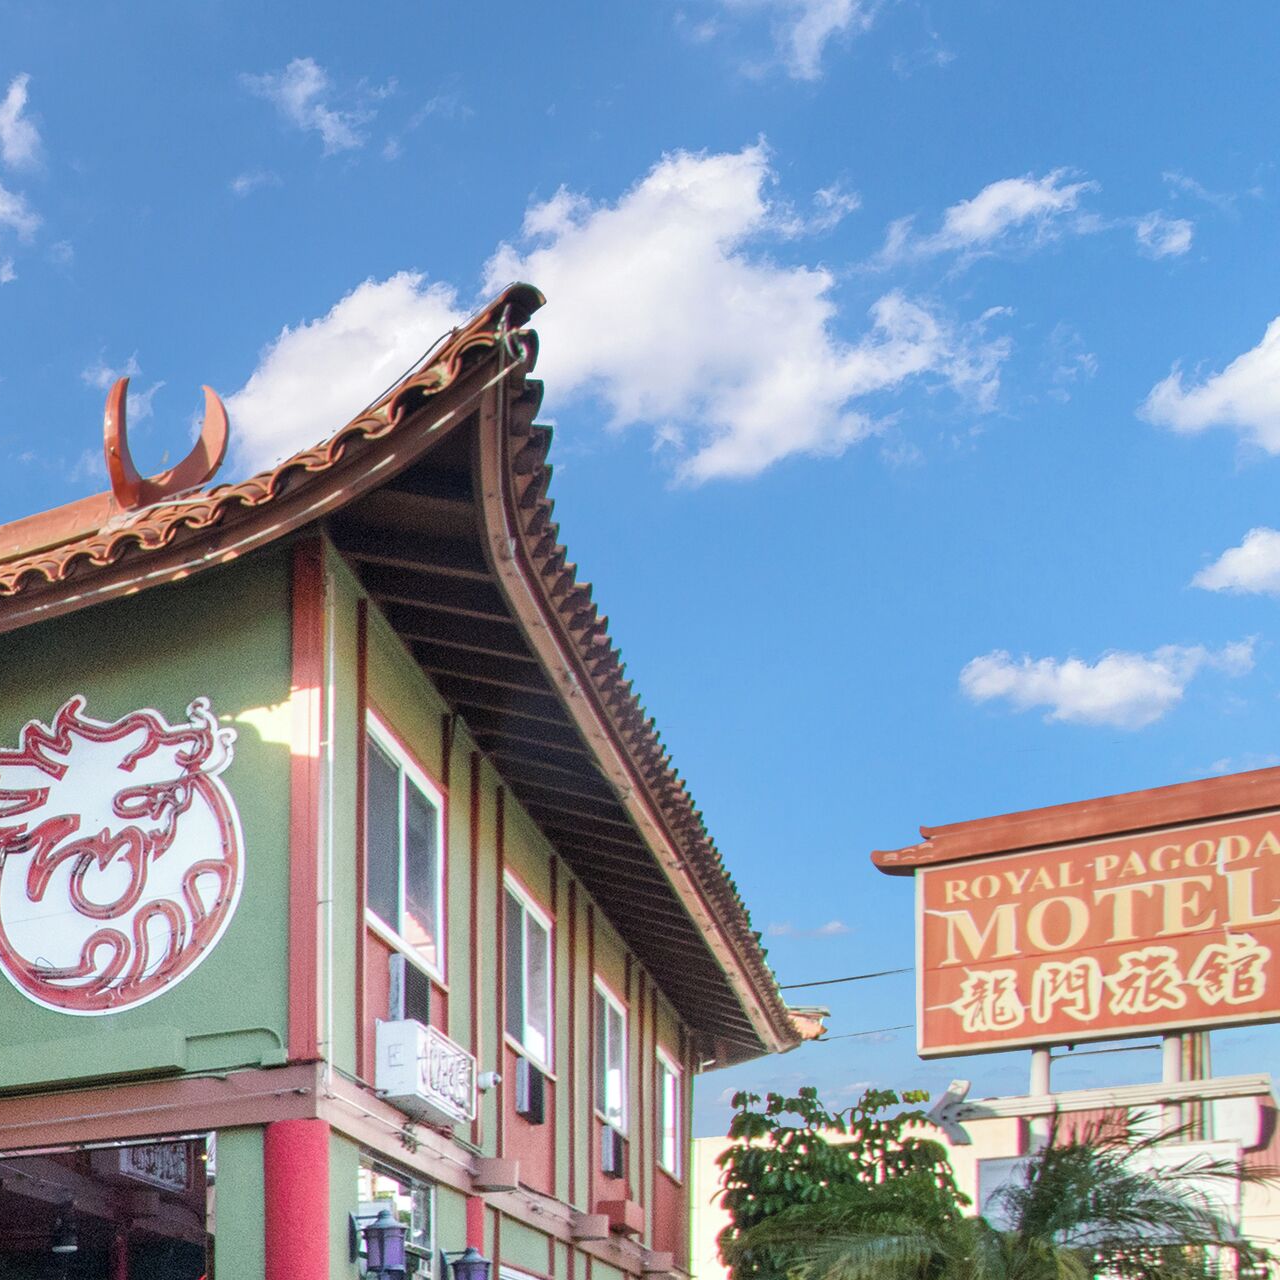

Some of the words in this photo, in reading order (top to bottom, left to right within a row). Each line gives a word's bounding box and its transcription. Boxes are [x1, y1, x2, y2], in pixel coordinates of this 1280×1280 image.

[944, 862, 1083, 904] ROYAL
[1096, 831, 1280, 881] PAGODA
[941, 867, 1280, 966] MOTEL
